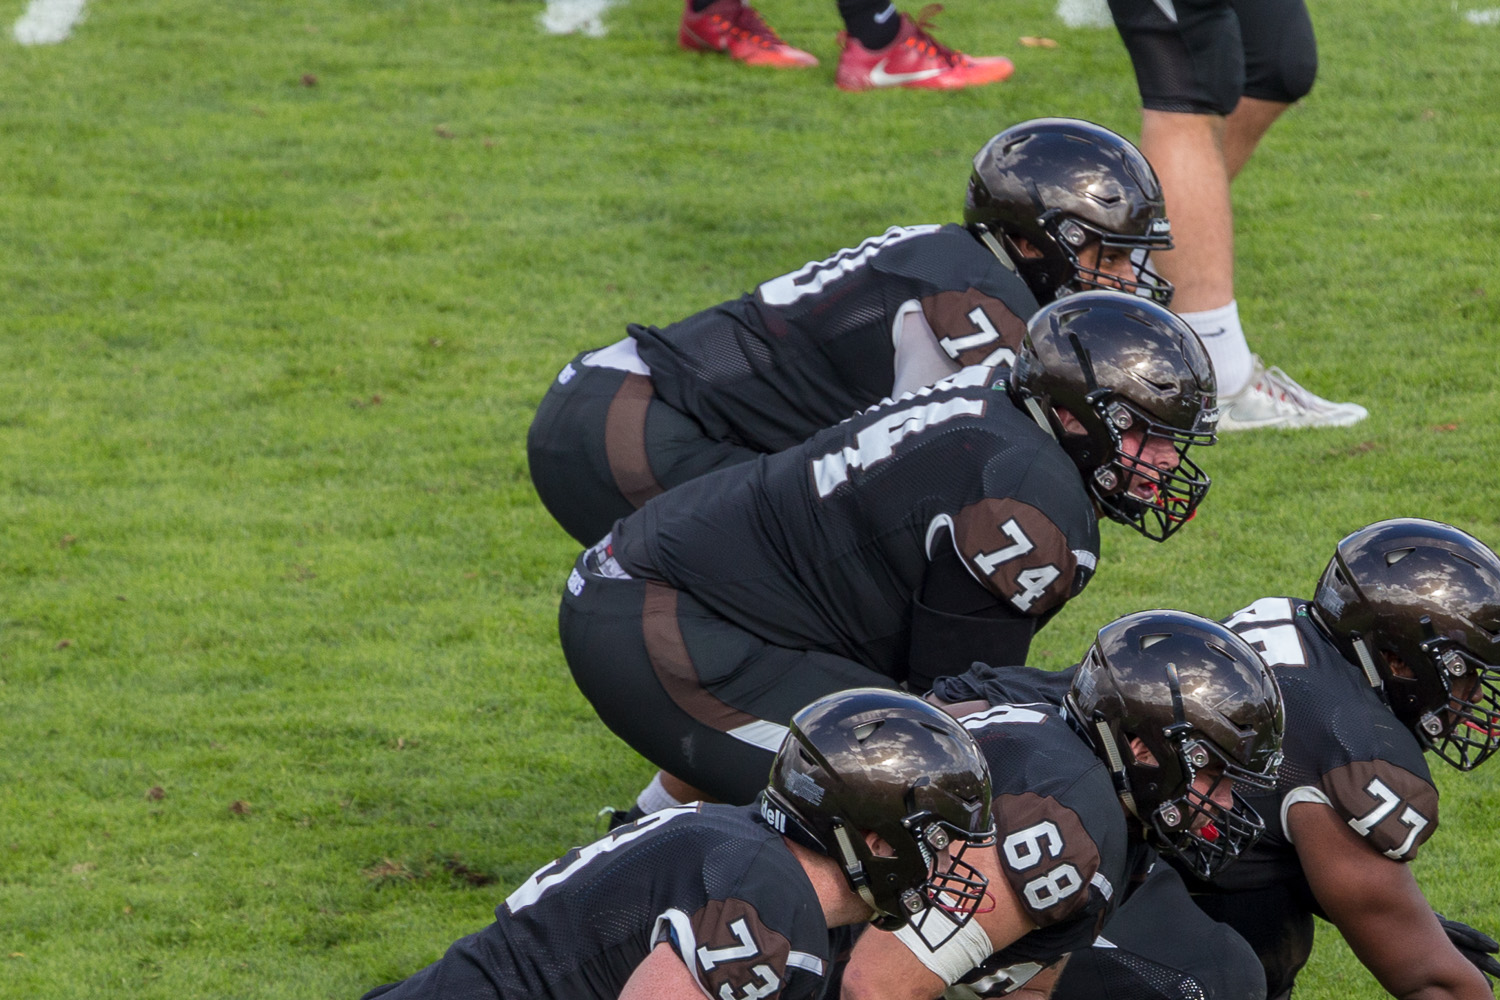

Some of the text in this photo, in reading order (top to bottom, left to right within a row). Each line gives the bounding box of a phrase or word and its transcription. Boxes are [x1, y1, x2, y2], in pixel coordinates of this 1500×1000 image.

[973, 519, 1061, 612] 74
[1348, 778, 1429, 860] 77
[1002, 820, 1083, 910] 68
